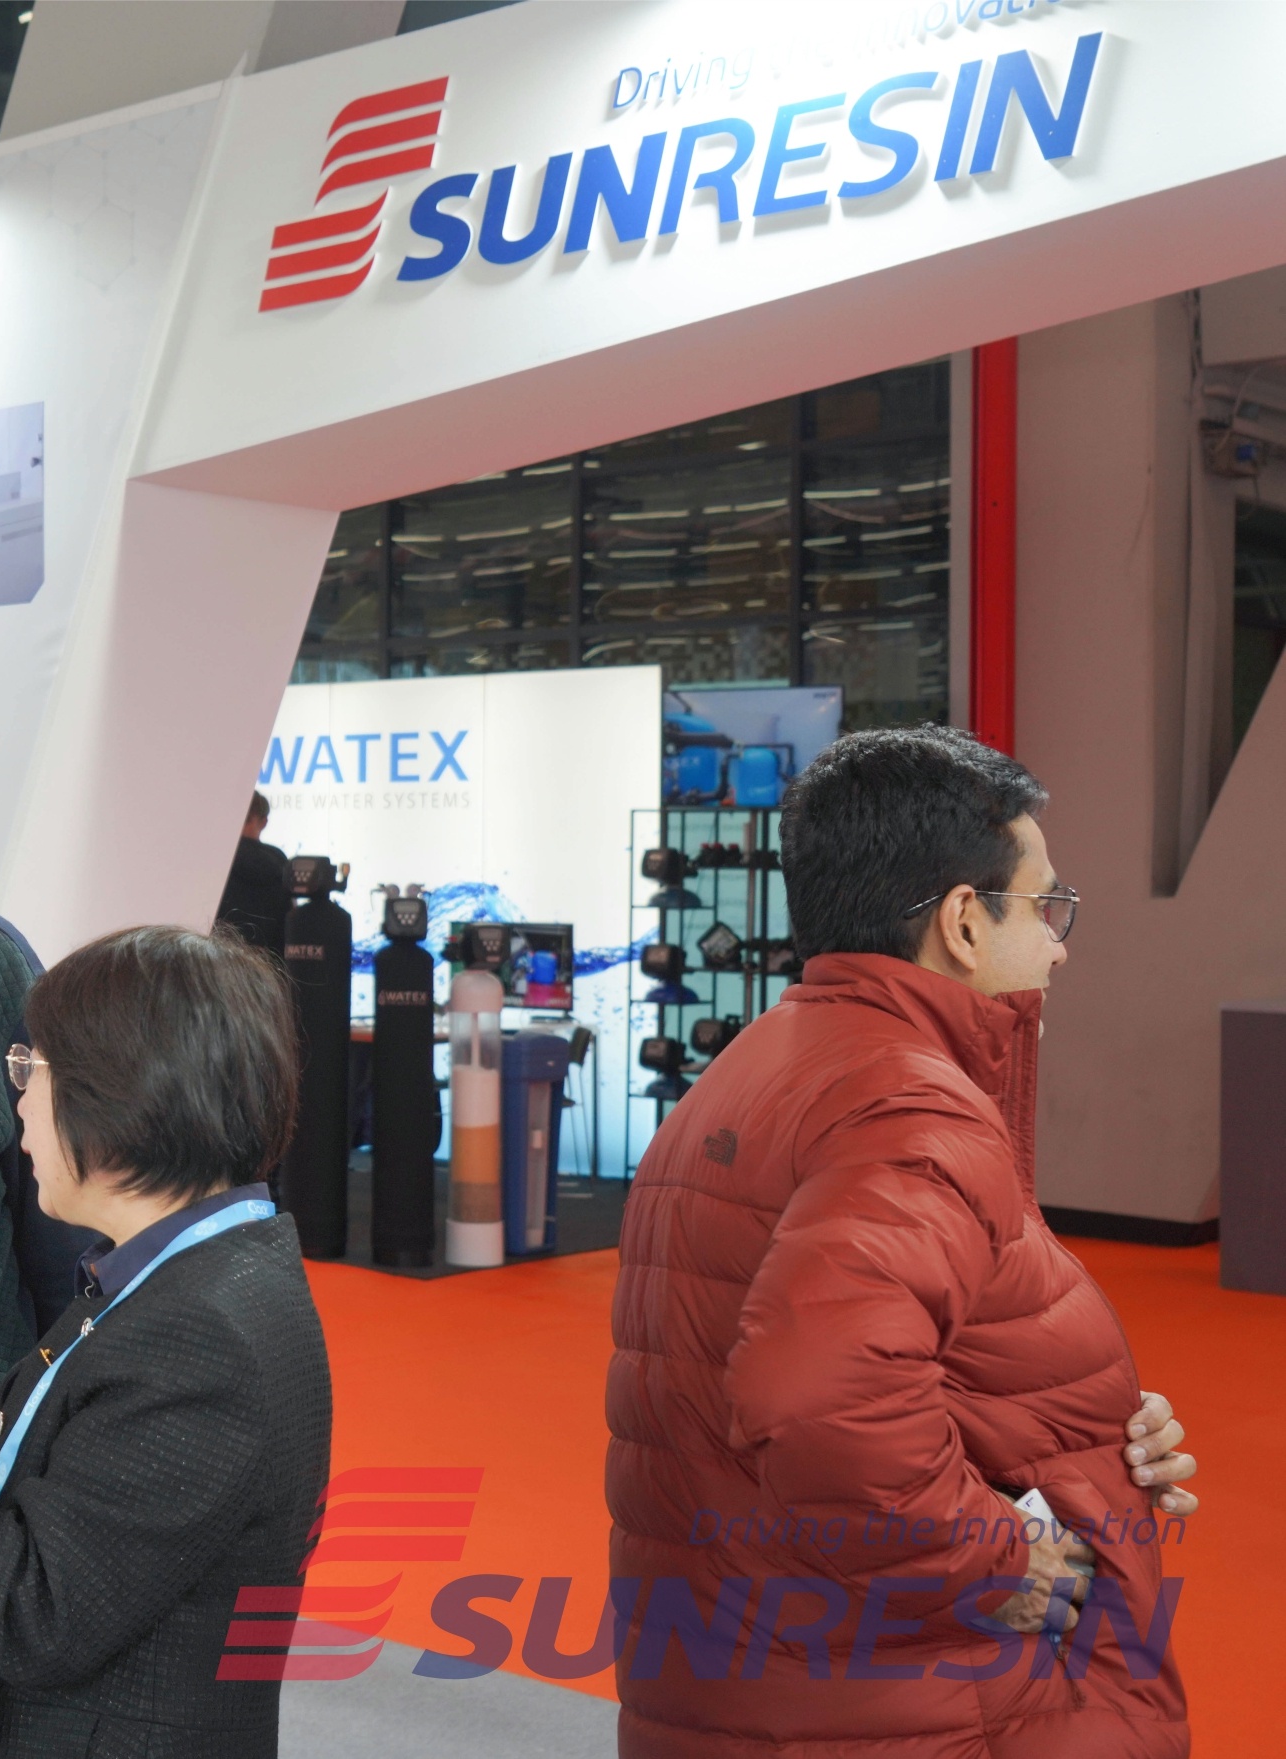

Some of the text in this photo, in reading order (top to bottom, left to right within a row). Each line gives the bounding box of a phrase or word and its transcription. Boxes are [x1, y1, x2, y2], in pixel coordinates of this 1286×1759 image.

[612, 48, 752, 110] Driving
[397, 31, 1103, 281] SUNRESIN
[257, 730, 469, 784] WATEX
[269, 790, 470, 810] URE WATER SYSTEMS
